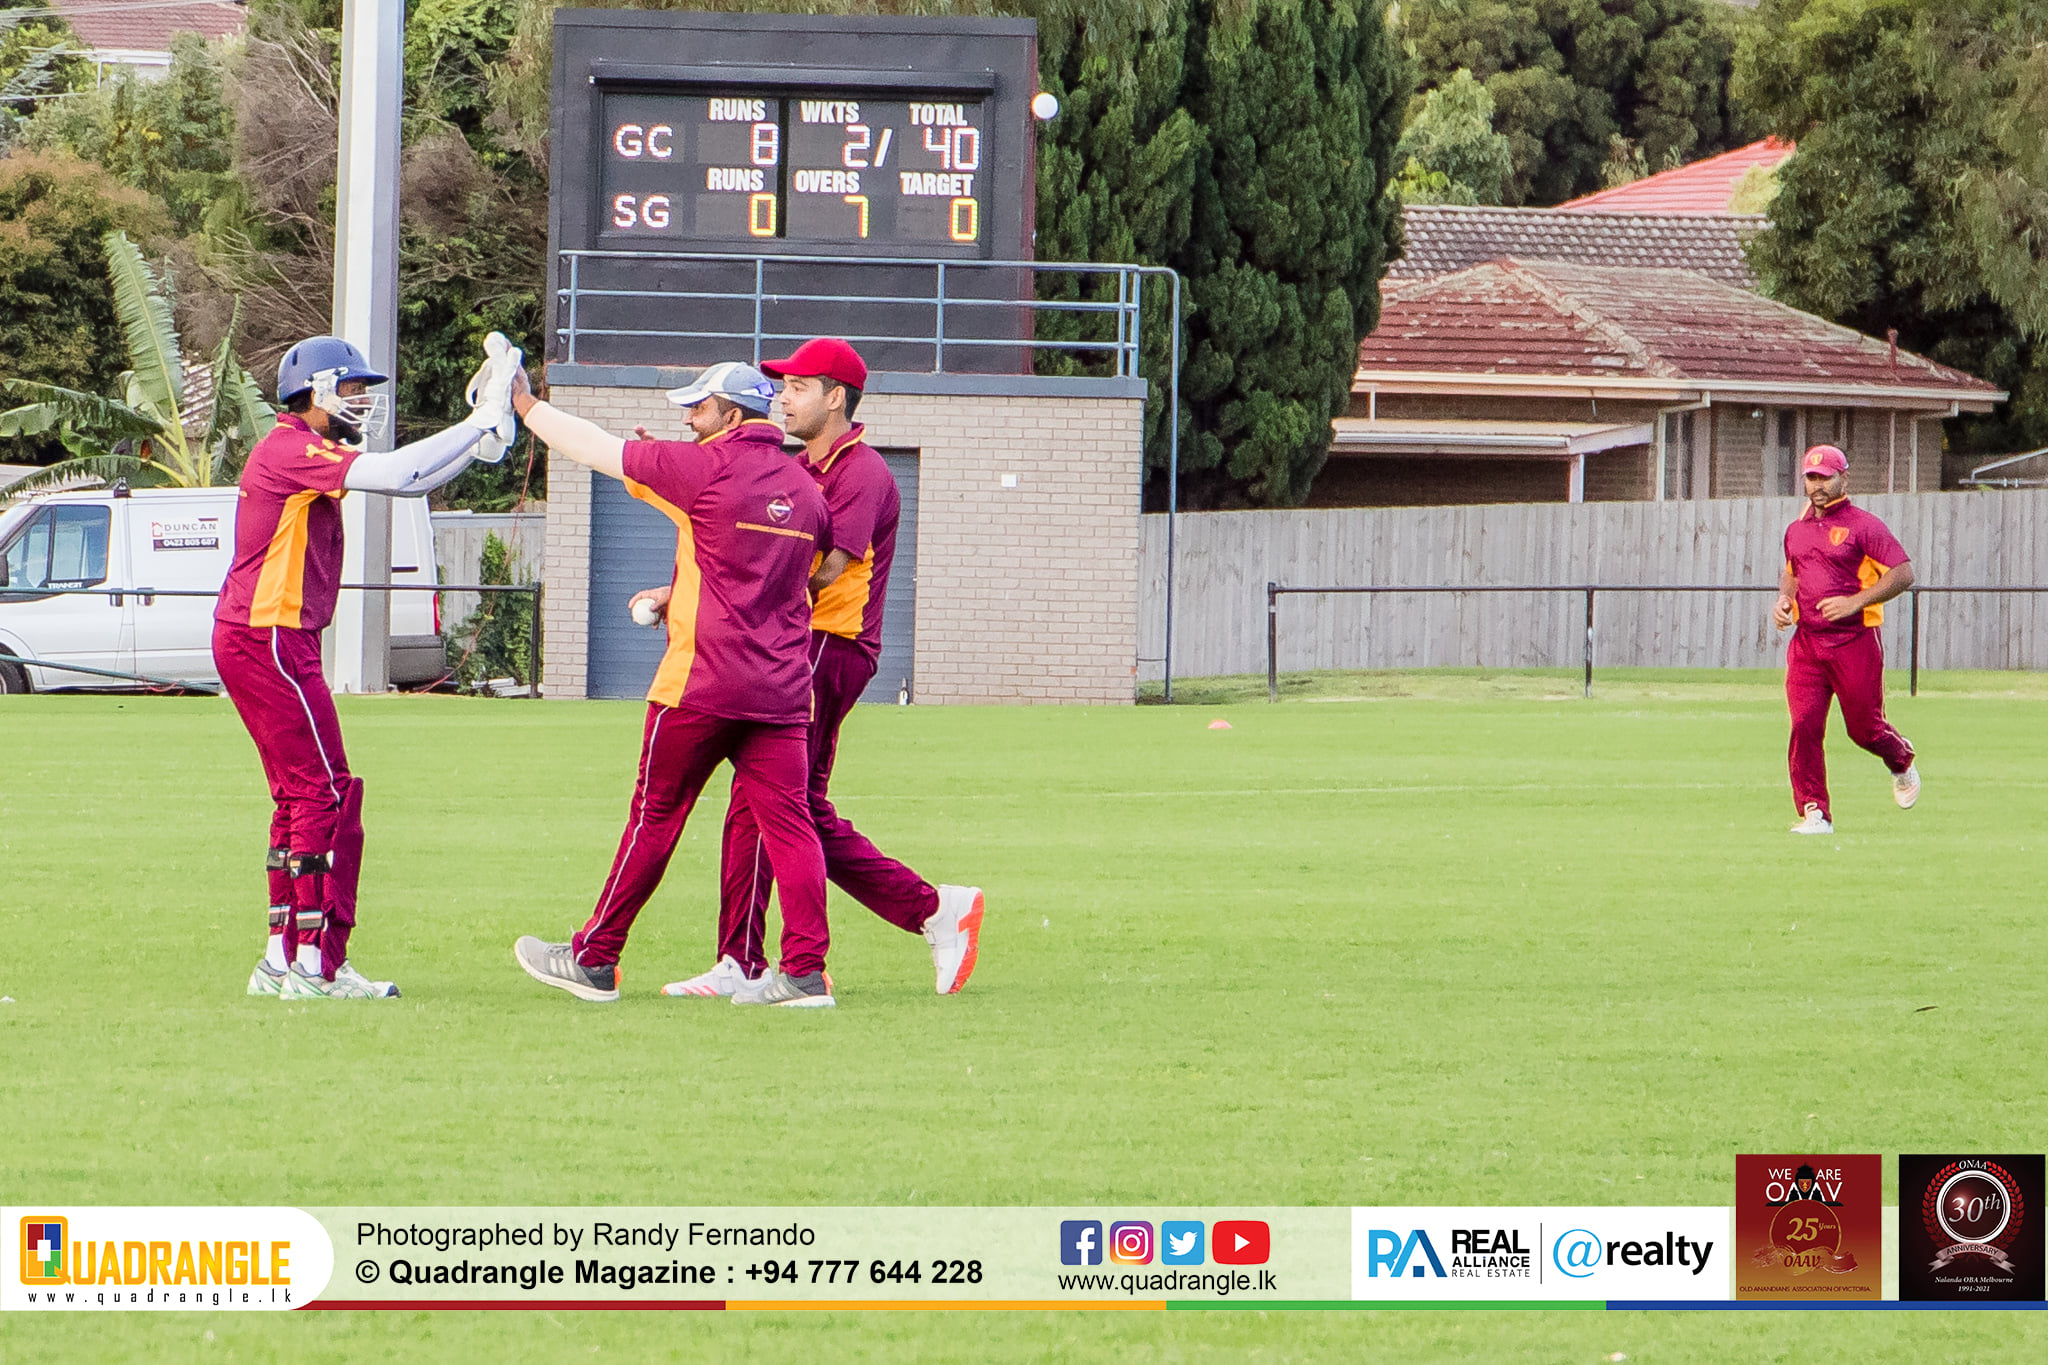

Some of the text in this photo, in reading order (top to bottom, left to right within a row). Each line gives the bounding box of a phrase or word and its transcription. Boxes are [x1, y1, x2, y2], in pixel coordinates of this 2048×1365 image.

[709, 98, 968, 126] RUNS WKTS TOTAL
[614, 124, 673, 158] GC
[752, 123, 779, 166] 8
[924, 127, 980, 170] 40
[707, 167, 974, 196] RUNS OVERS TARGET
[613, 193, 978, 241] SG 0 7 0
[164, 523, 217, 531] DUNCAN
